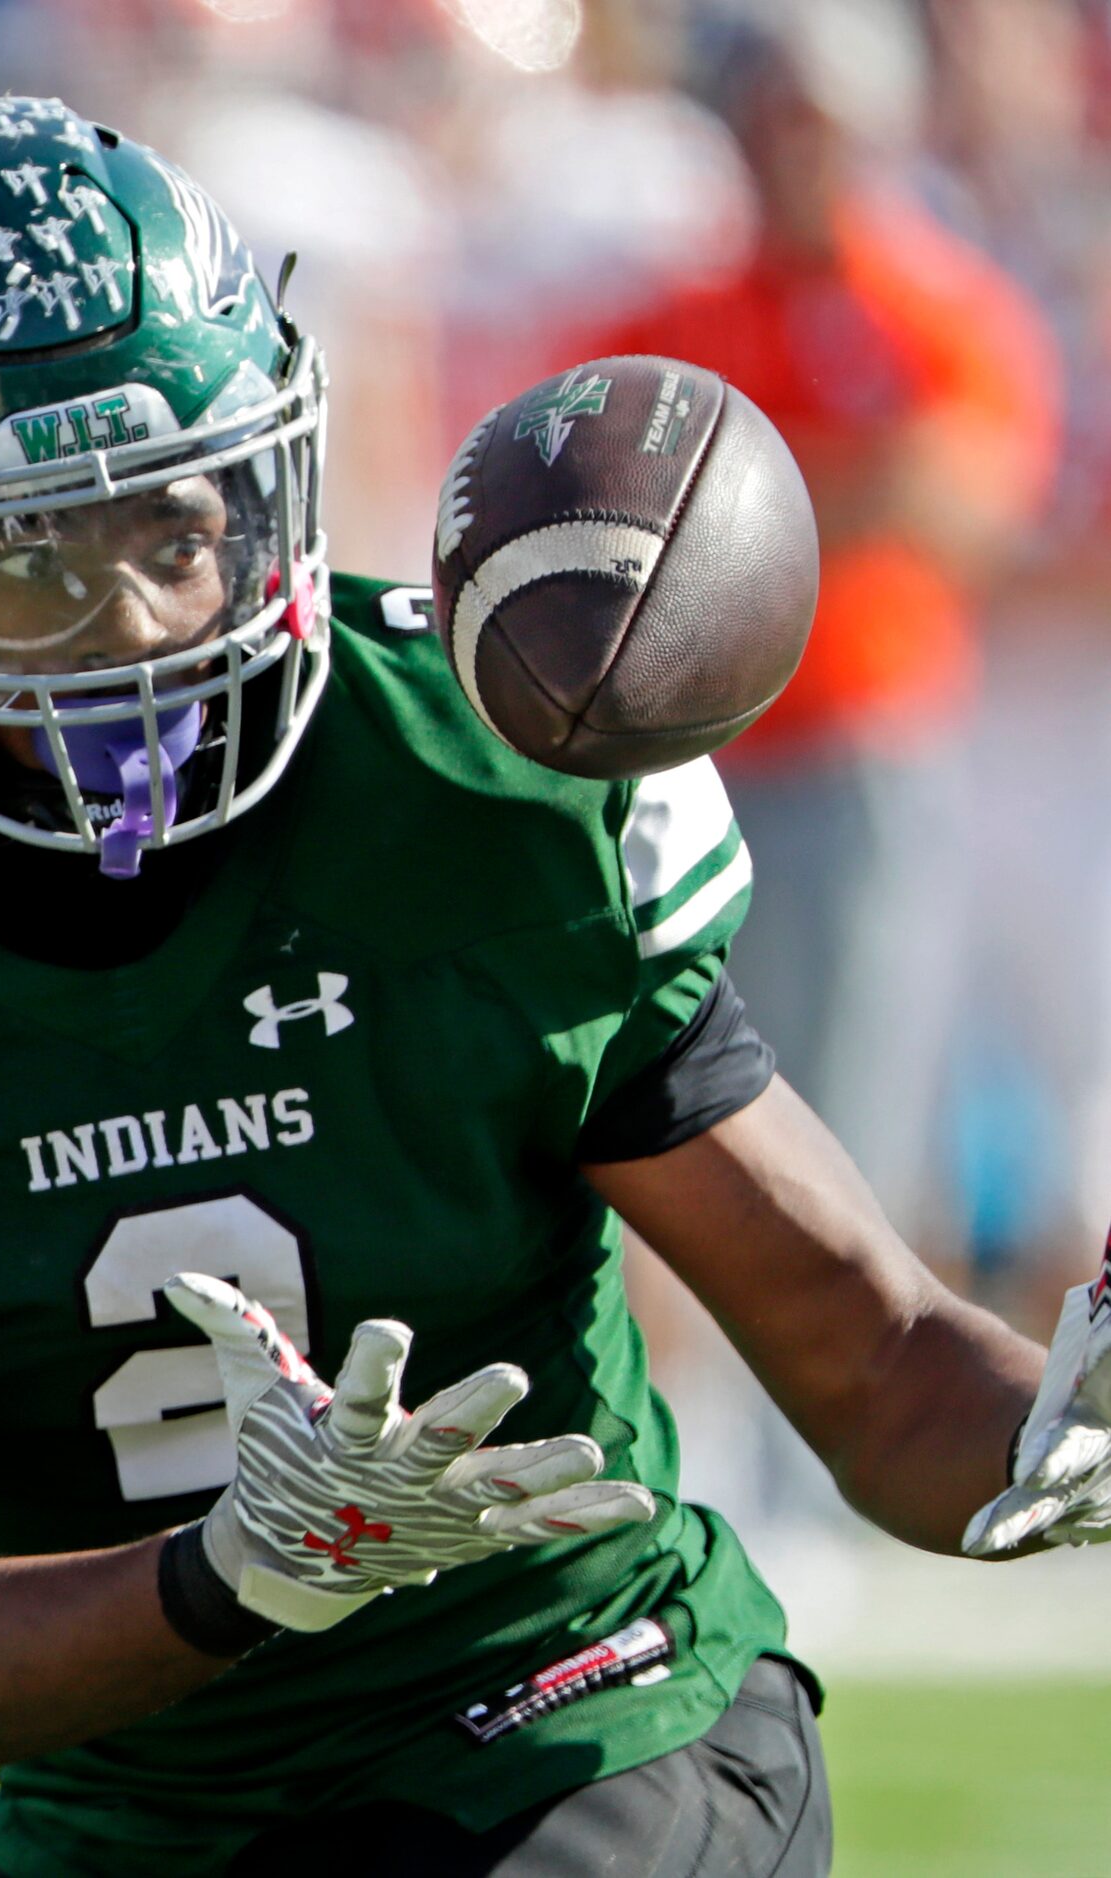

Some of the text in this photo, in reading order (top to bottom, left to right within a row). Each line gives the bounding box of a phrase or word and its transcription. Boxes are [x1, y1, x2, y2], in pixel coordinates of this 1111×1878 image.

[10, 393, 149, 464] W.I.T.
[642, 402, 671, 453] TEAM
[20, 1088, 314, 1192] INDIANS
[82, 1192, 312, 1502] 2
